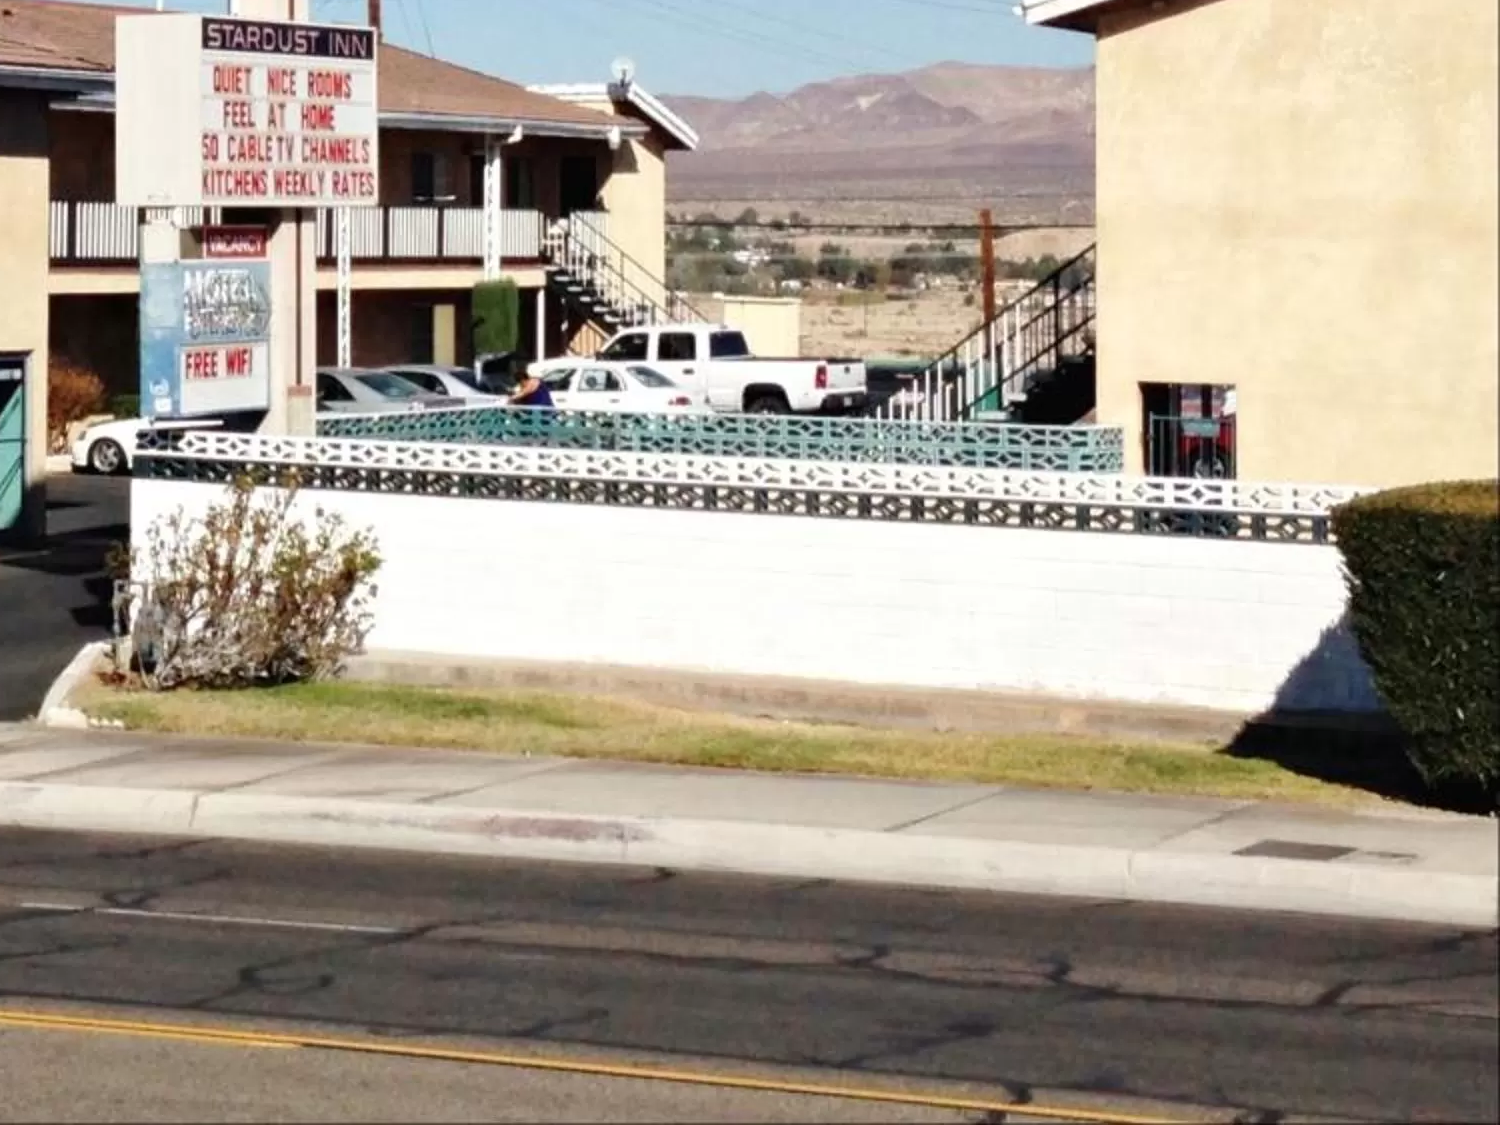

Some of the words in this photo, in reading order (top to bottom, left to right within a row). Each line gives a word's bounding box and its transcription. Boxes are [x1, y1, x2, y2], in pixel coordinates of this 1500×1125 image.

[206, 23, 320, 53] STARDUST
[329, 30, 368, 57] INN
[213, 64, 252, 95] QUIET
[267, 67, 296, 96] NICE
[308, 70, 352, 98] ROOMS
[223, 101, 256, 129] FEEL
[268, 102, 286, 127] AT
[301, 104, 335, 131] HOME
[202, 134, 219, 161] 50
[227, 135, 273, 162] CABLE
[276, 135, 295, 163] TV
[301, 137, 370, 164] CHANNELS
[203, 169, 267, 196] KITCHENS
[274, 171, 325, 197] WEEKLY
[331, 172, 375, 197] RATES
[185, 350, 219, 379] FREE
